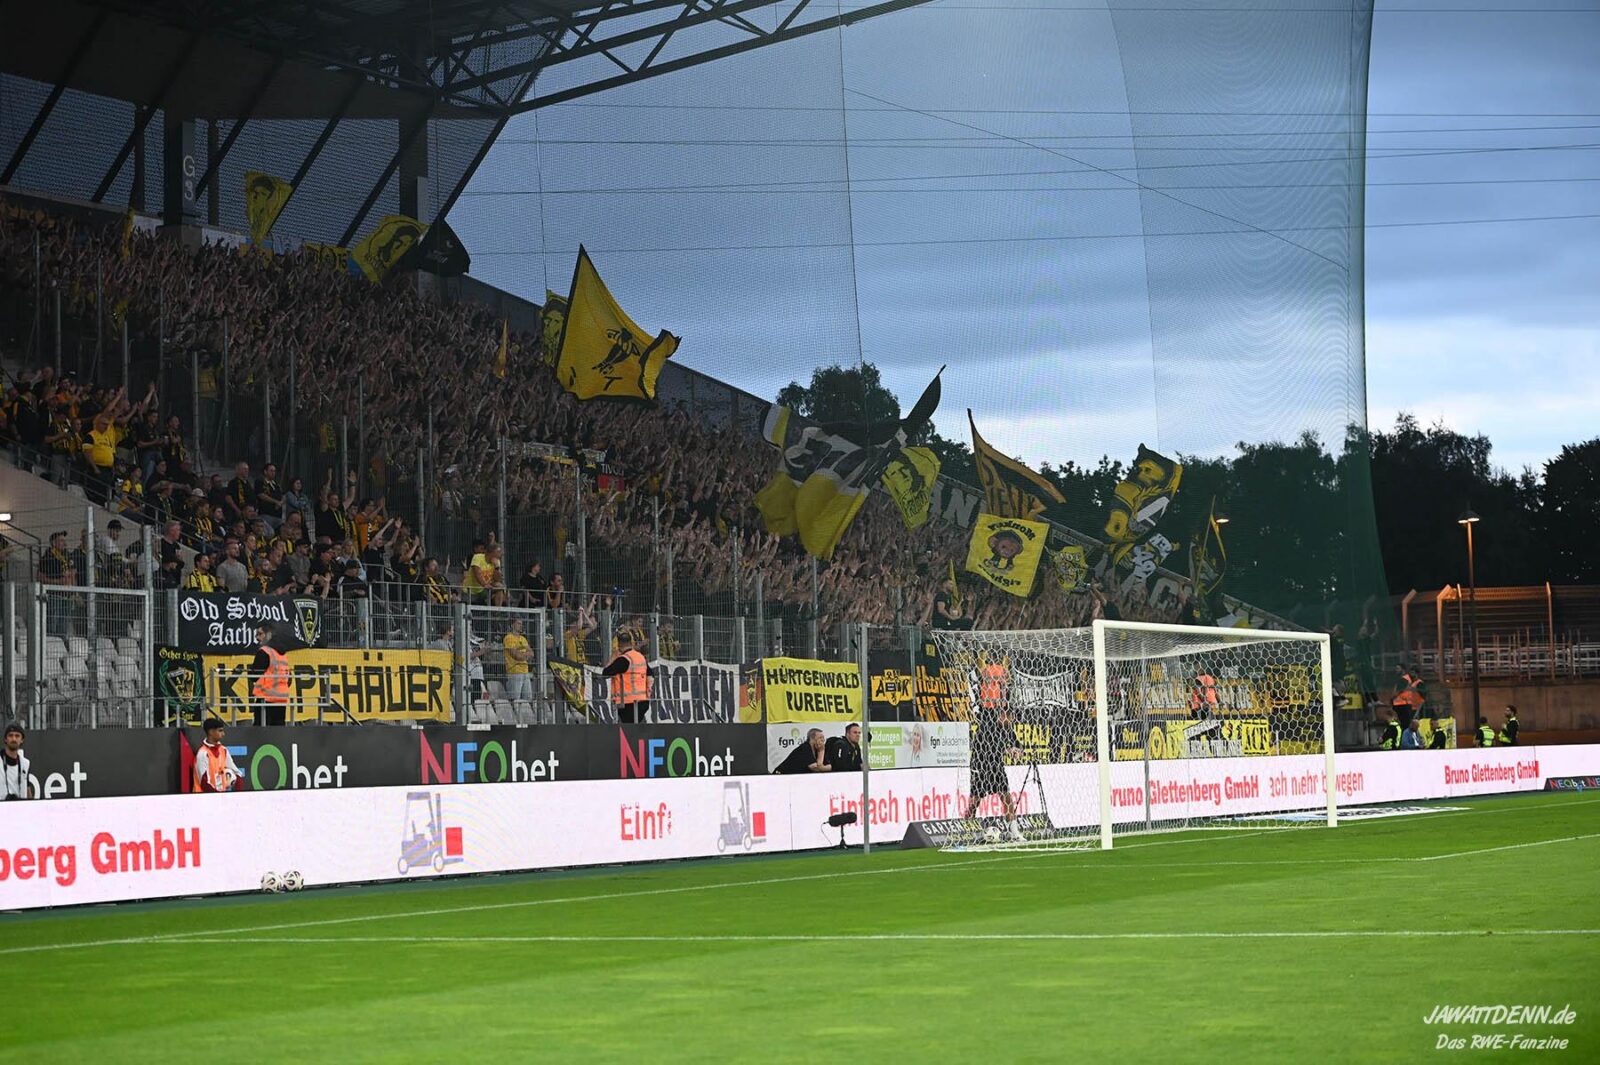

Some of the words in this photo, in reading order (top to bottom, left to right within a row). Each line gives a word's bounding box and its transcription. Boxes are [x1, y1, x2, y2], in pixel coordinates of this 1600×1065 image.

[180, 597, 219, 621] Old
[226, 596, 290, 623] School
[206, 621, 260, 648] Aache
[766, 664, 860, 689] HÜRTGENWALD
[778, 736, 795, 748] fgn
[930, 735, 941, 750] fgn
[1444, 765, 1470, 785] Bruno
[1471, 763, 1516, 784] Glettenberg
[1224, 775, 1259, 801] GmbH
[90, 826, 202, 876] GmbH
